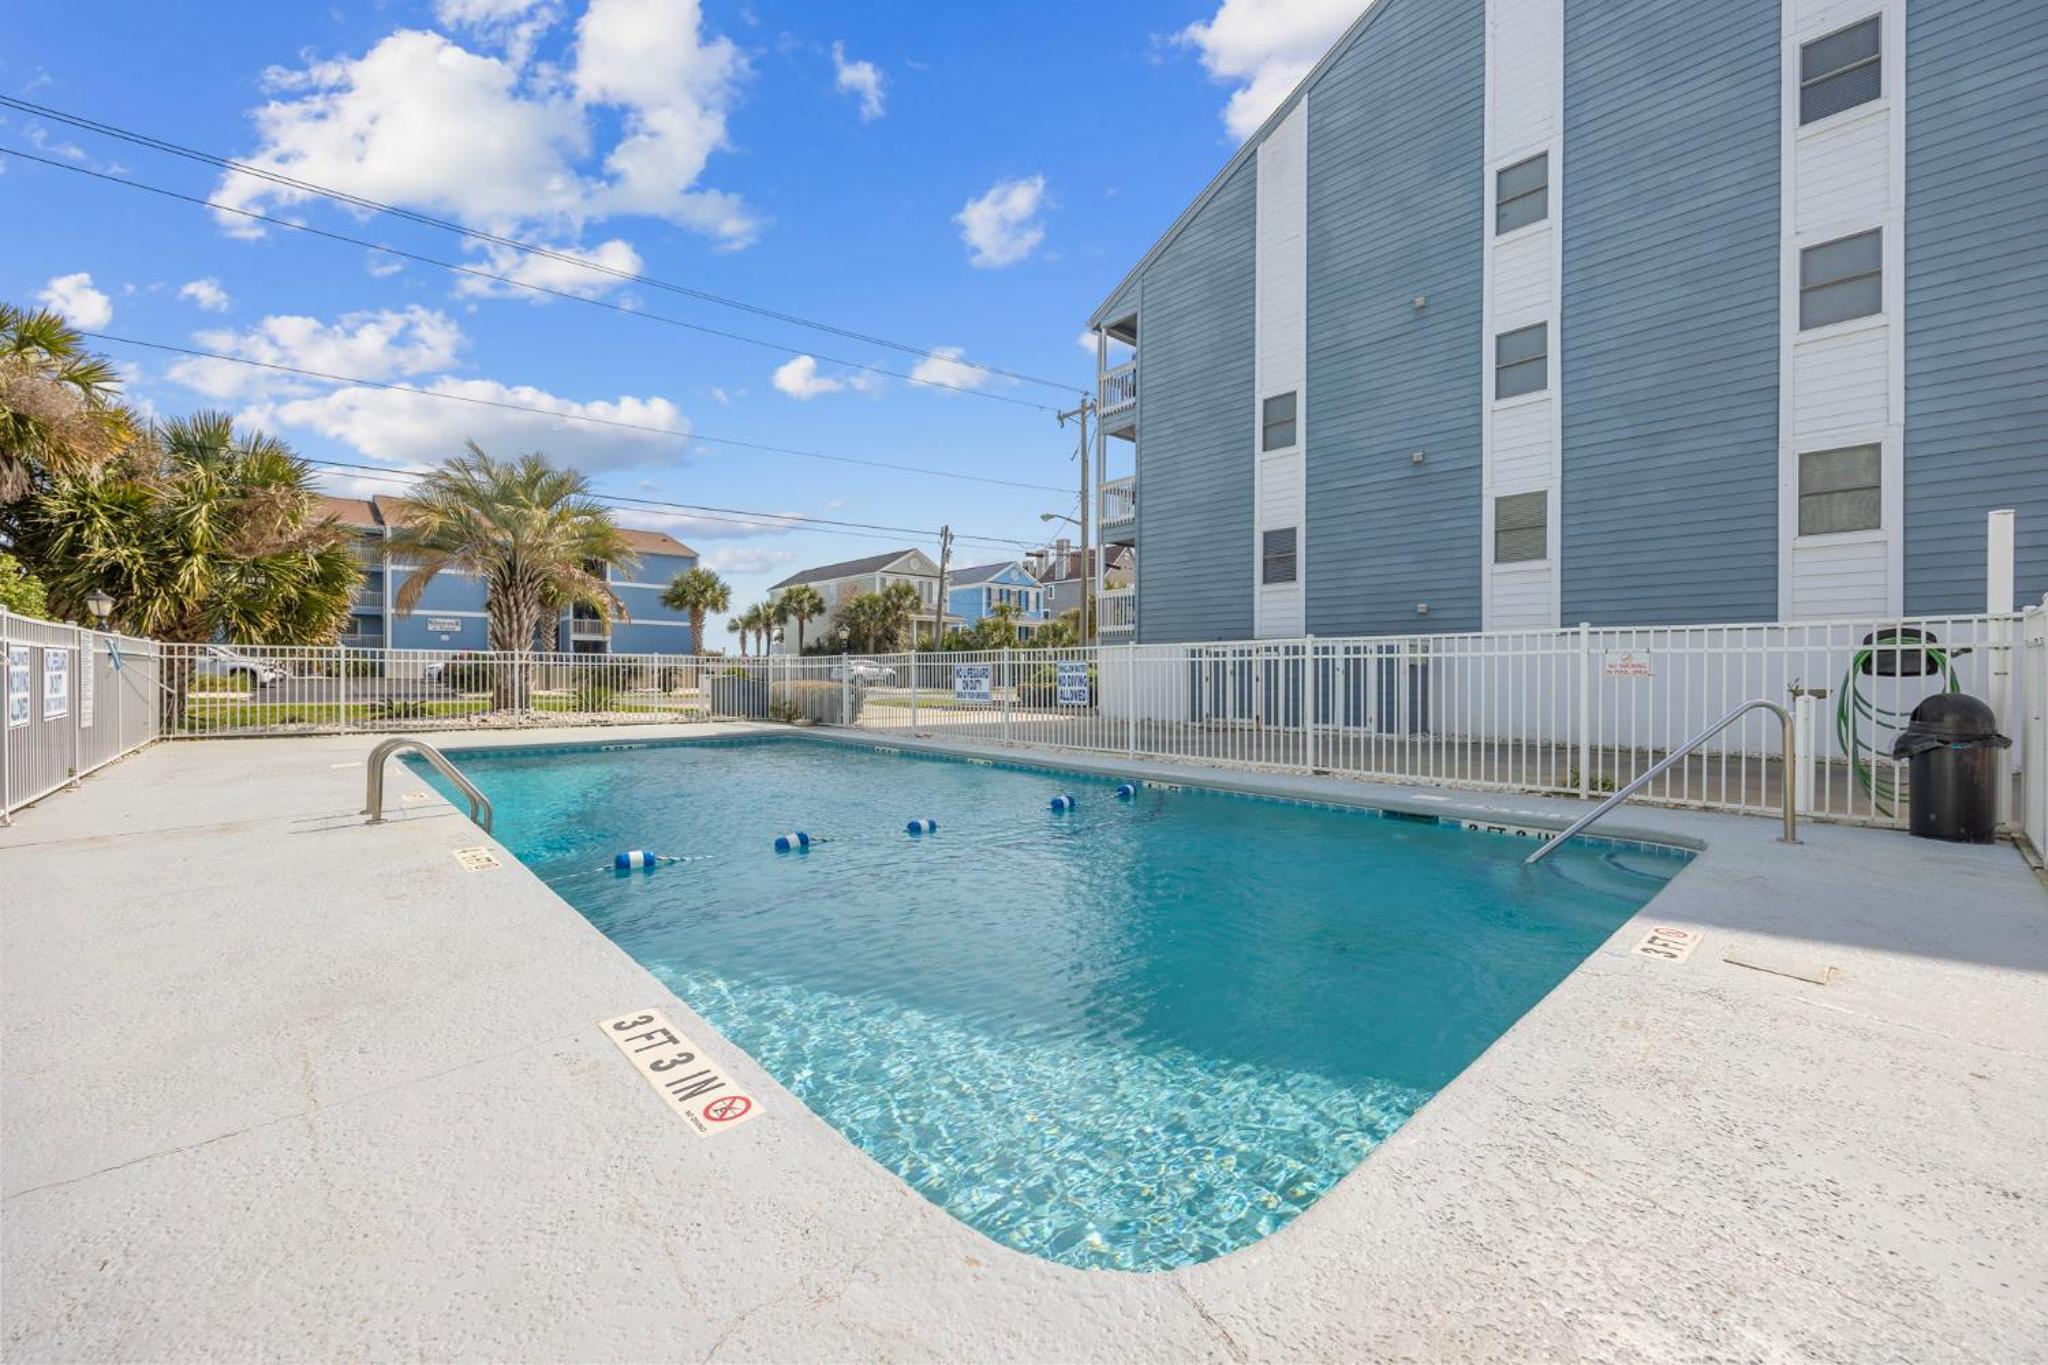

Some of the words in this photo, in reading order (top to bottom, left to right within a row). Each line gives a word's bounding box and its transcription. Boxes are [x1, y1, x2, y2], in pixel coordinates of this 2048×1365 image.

[1059, 674, 1066, 687] NO
[1067, 674, 1088, 688] DIVING
[1059, 689, 1086, 701] ALLOWED
[1647, 935, 1689, 952] FT
[1640, 947, 1679, 959] 3
[612, 1014, 655, 1031] 3
[624, 1027, 680, 1053] FT
[649, 1051, 695, 1072] 3
[665, 1069, 727, 1102] IN
